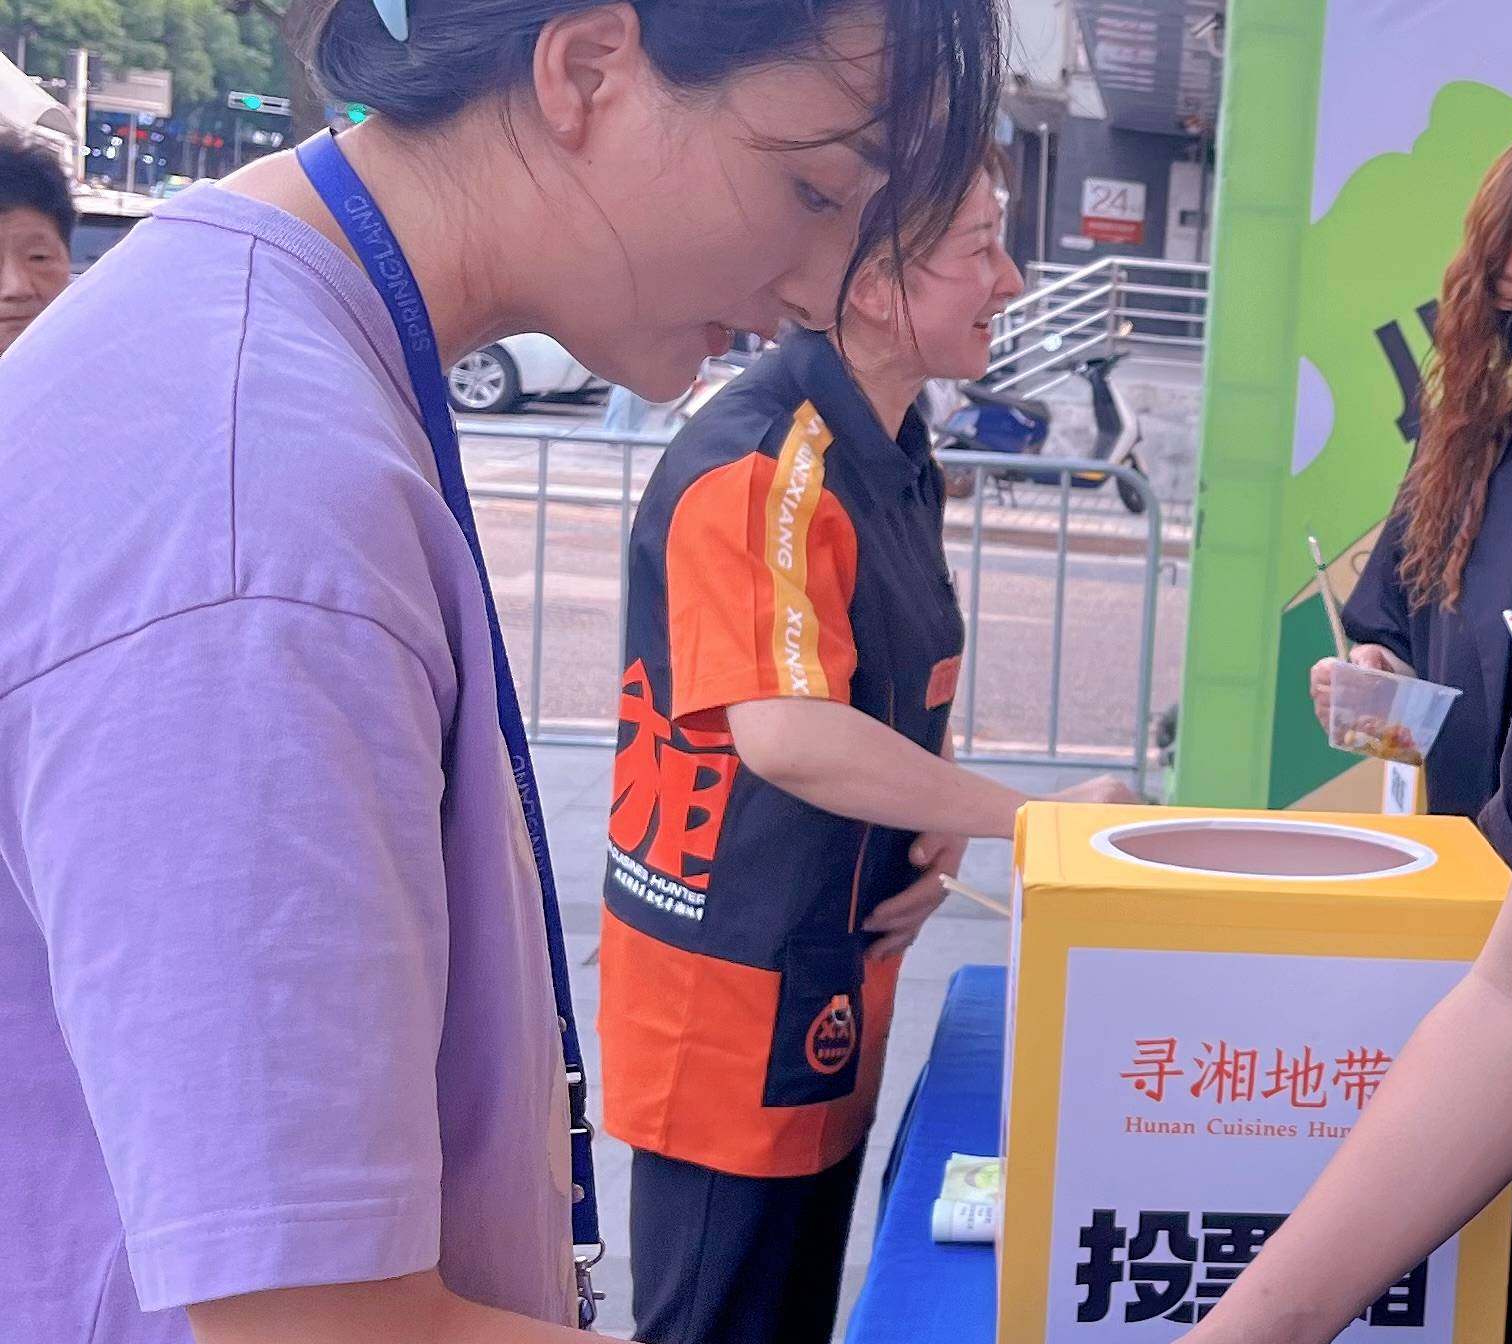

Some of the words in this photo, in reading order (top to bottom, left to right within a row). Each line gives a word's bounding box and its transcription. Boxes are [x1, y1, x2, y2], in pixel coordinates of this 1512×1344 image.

[1120, 1037, 1393, 1111] 寻湘地带
[1125, 1116, 1196, 1135] Hunan
[1206, 1118, 1298, 1137] Cuisines
